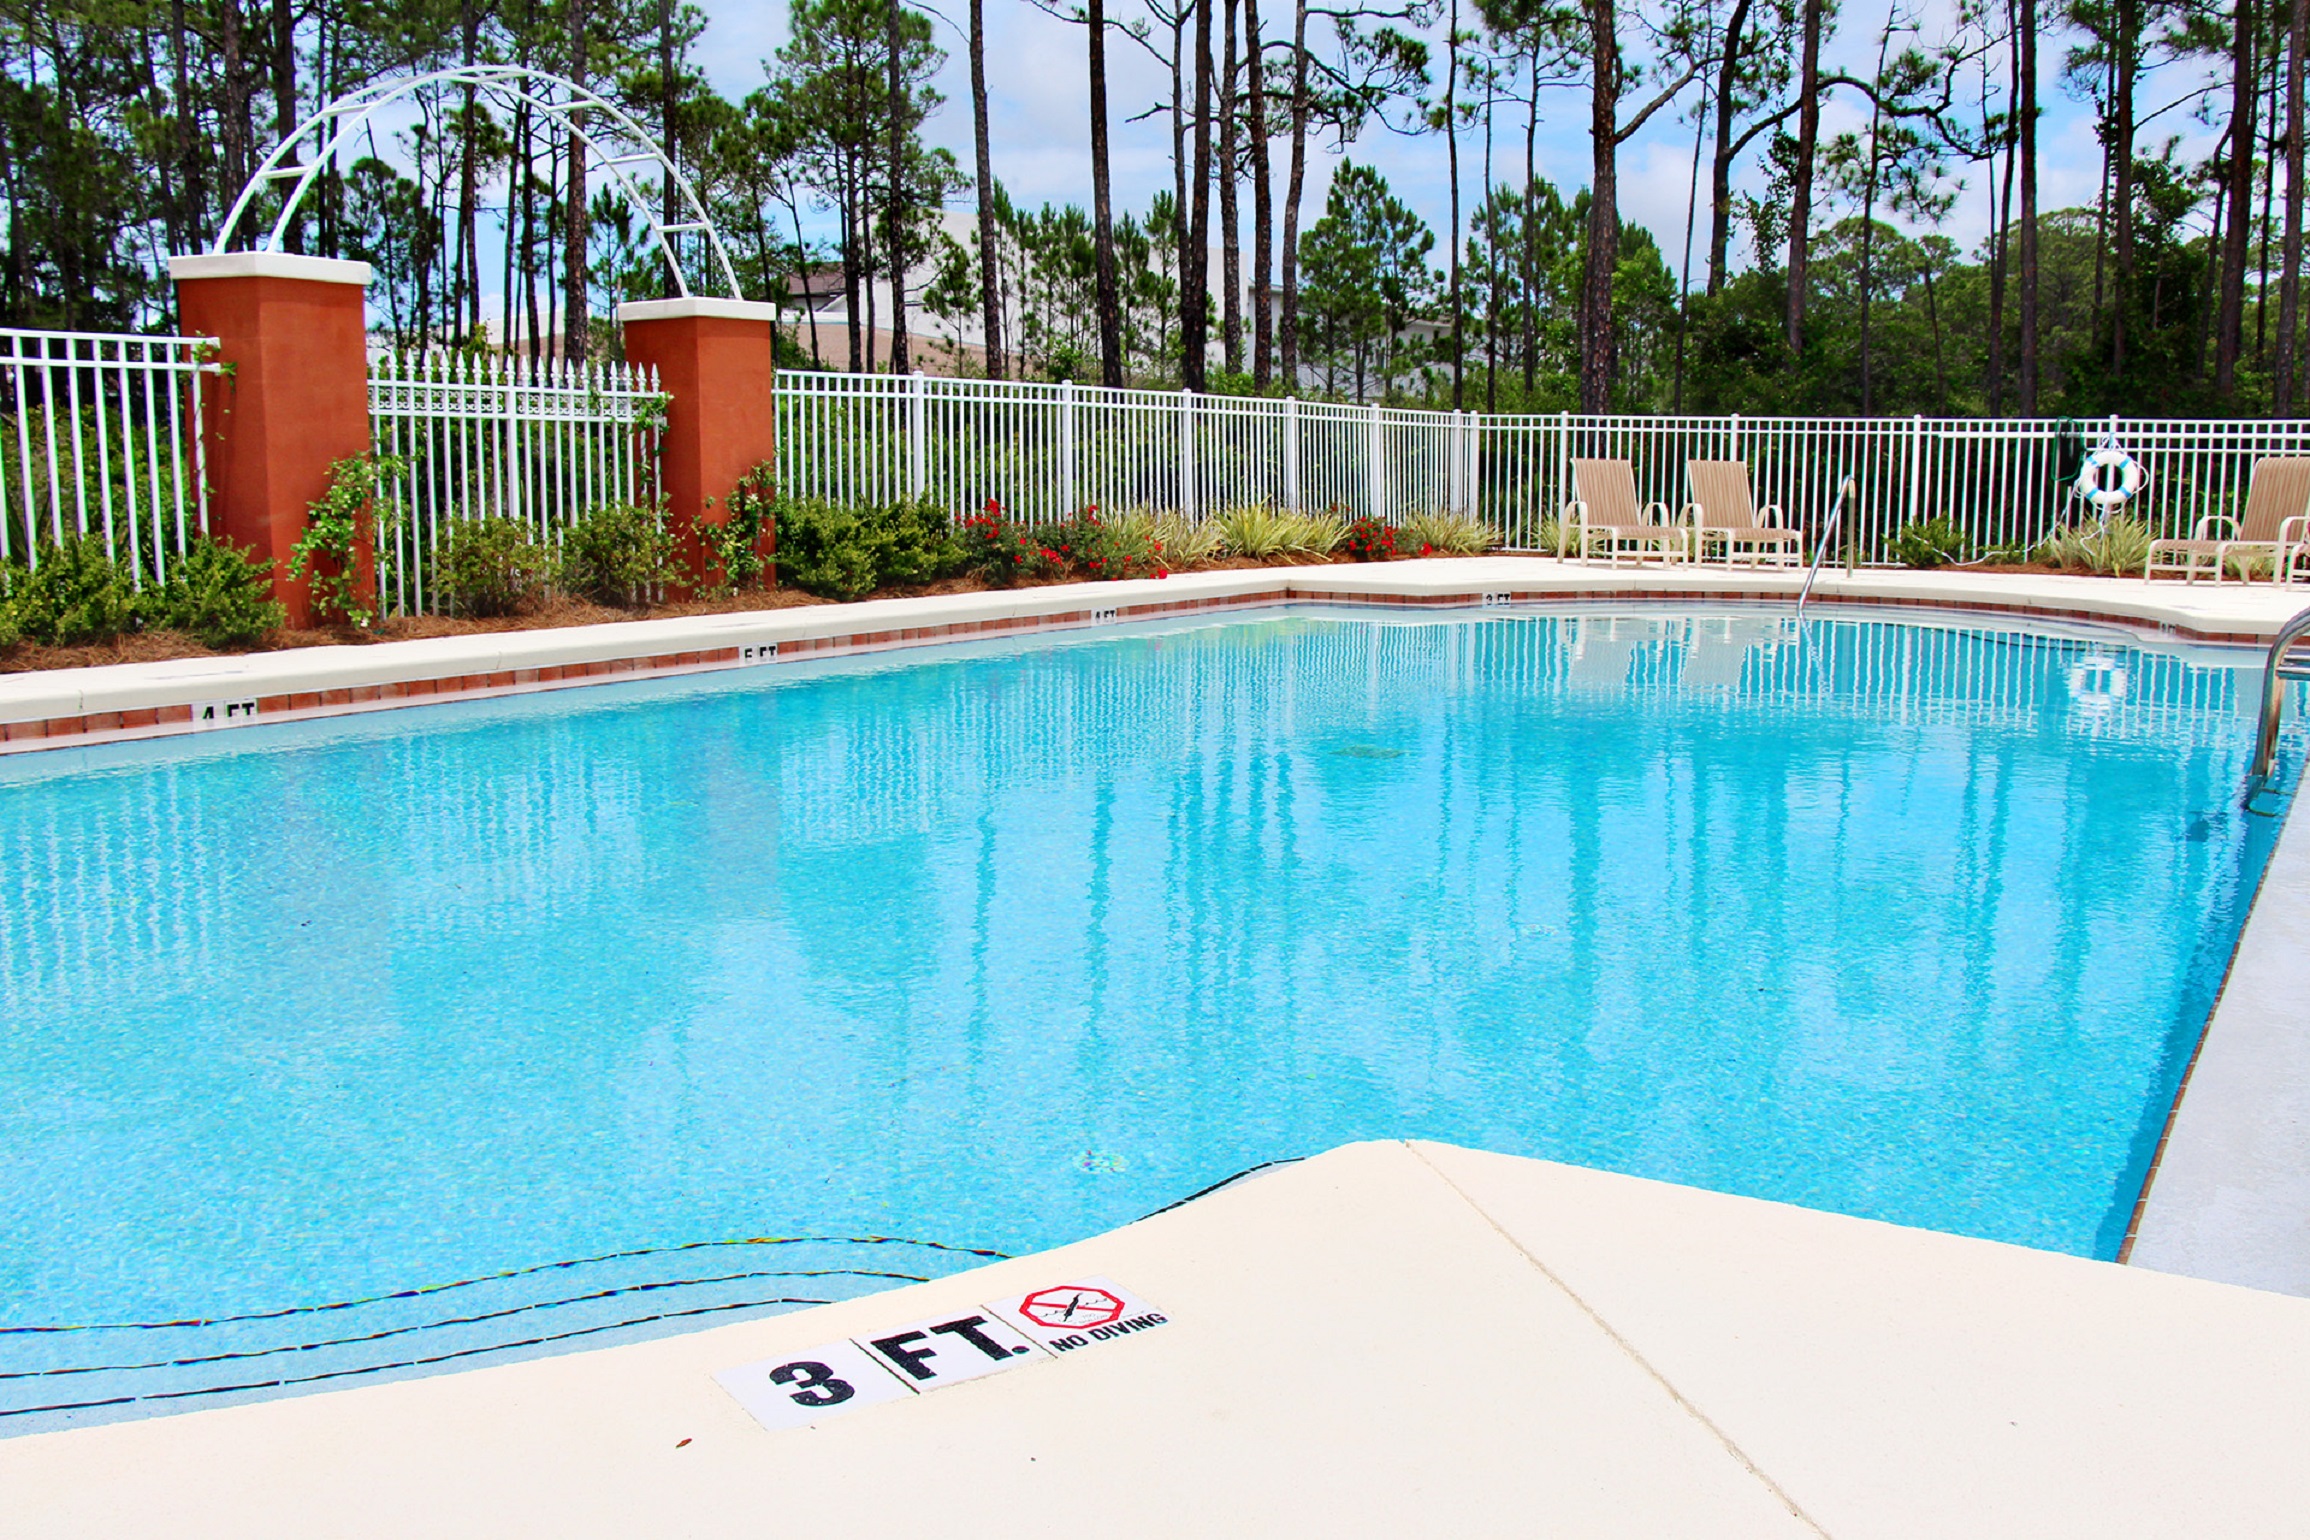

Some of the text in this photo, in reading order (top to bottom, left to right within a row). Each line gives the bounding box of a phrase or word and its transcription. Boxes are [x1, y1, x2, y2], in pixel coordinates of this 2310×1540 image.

[1103, 610, 1115, 618] FT
[760, 646, 776, 657] FT
[226, 703, 254, 717] FT
[1048, 1334, 1089, 1352] NO
[1088, 1313, 1168, 1341] DIVING
[769, 1315, 1030, 1406] 3 FT.
